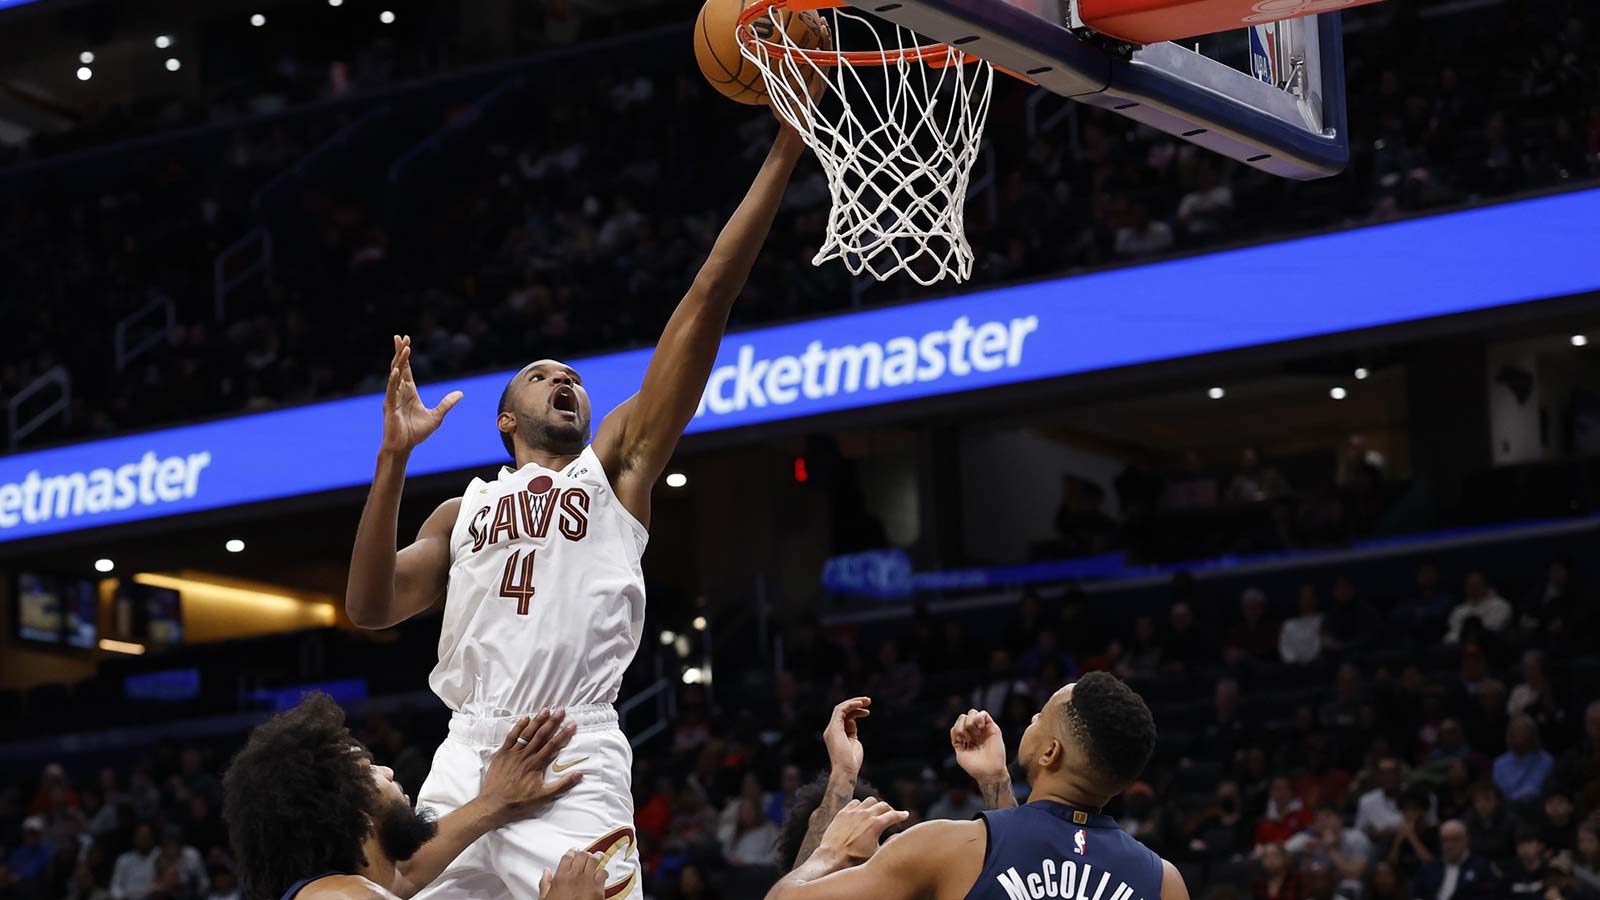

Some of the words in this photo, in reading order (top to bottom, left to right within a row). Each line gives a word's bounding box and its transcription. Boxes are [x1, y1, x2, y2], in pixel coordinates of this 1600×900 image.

[694, 315, 1038, 418] cketmaster
[468, 487, 590, 553] CAVS
[500, 549, 535, 615] 4
[996, 858, 1144, 900] McCOLL
